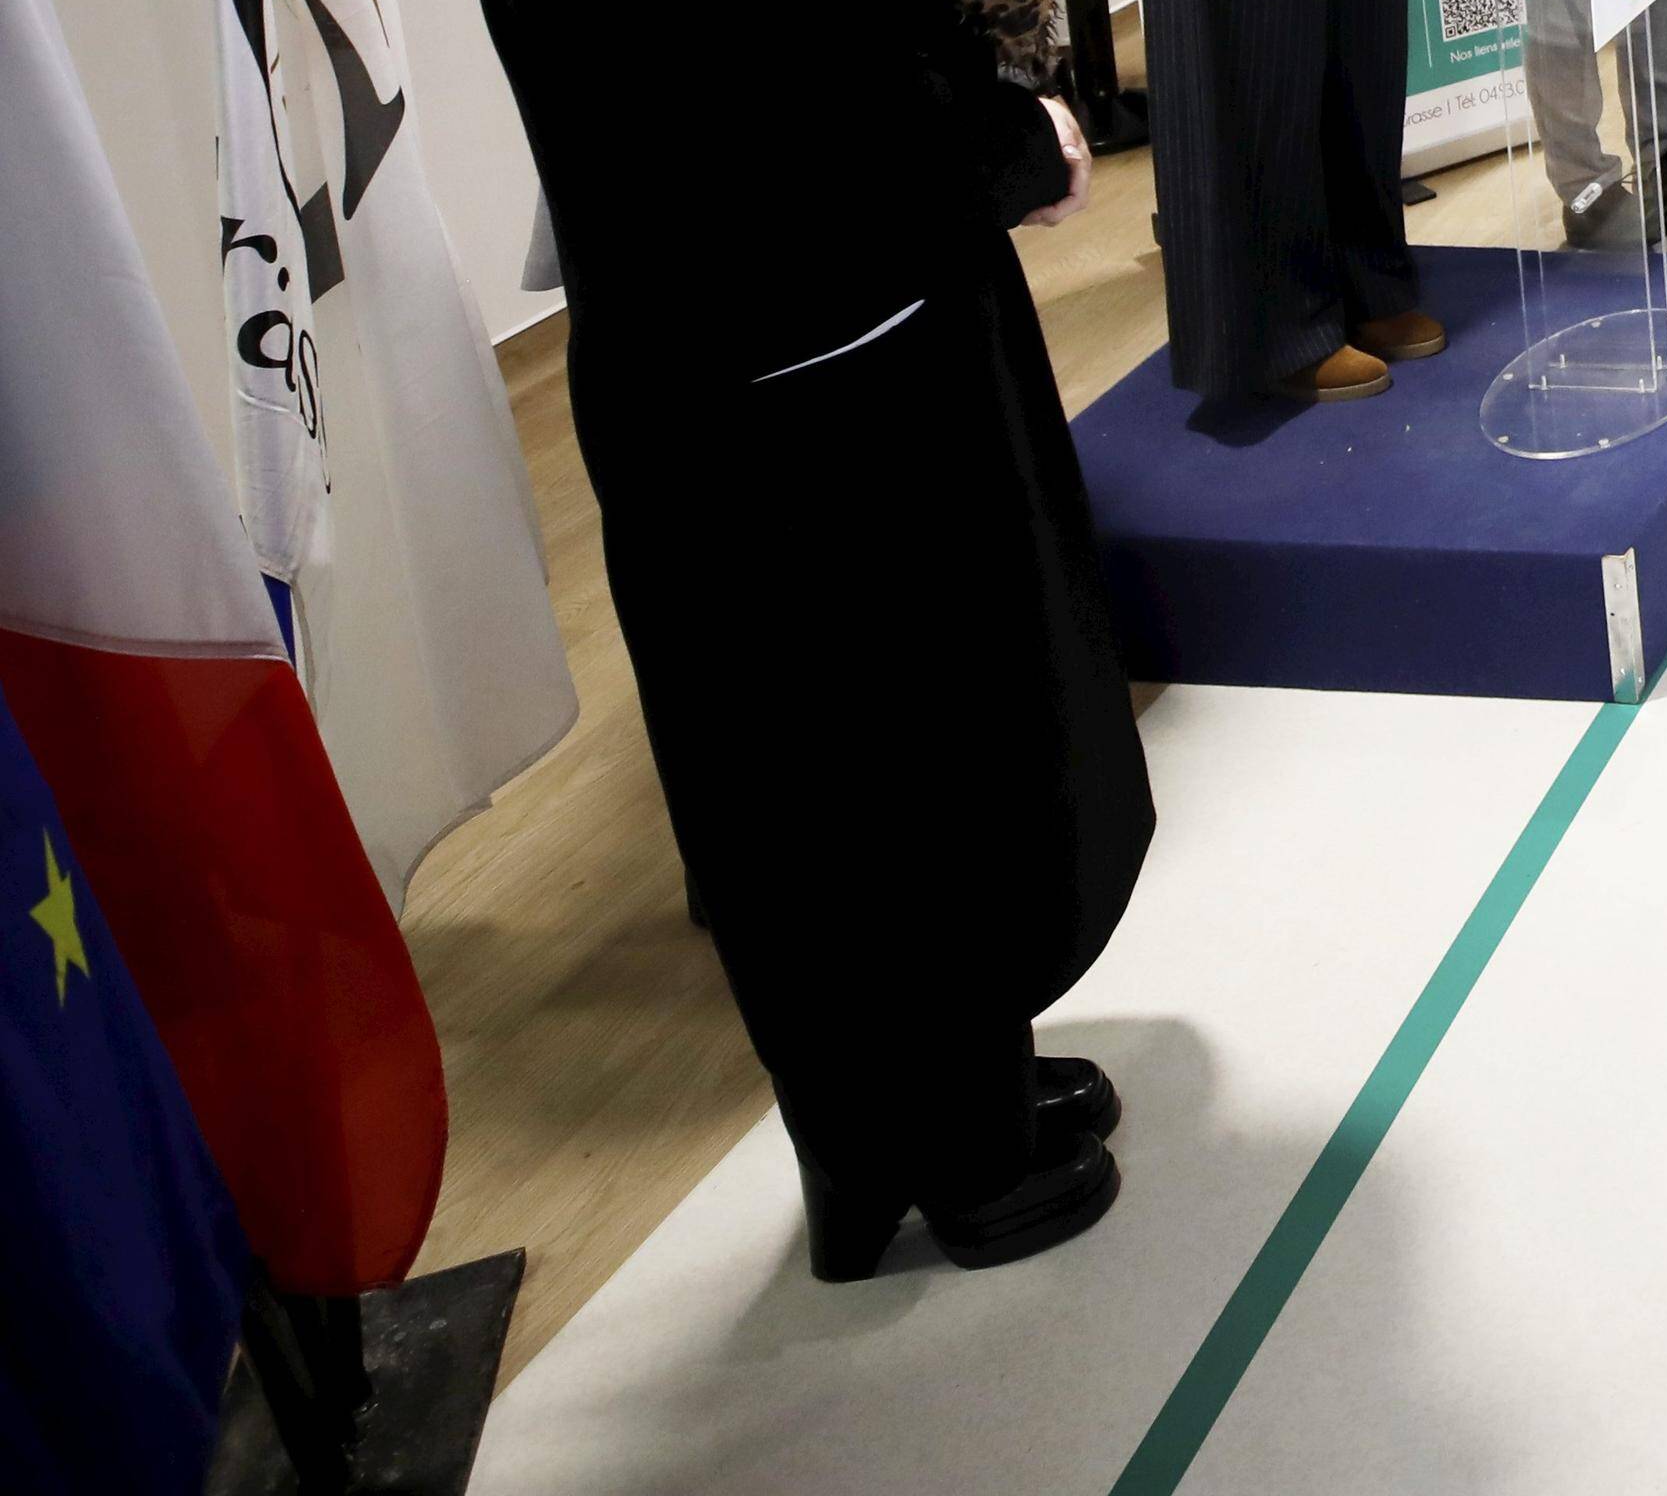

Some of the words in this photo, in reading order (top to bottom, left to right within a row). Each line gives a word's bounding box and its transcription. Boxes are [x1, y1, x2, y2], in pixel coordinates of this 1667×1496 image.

[1449, 49, 1473, 64] Nos
[1473, 42, 1498, 56] liens
[1405, 105, 1442, 126] rasse
